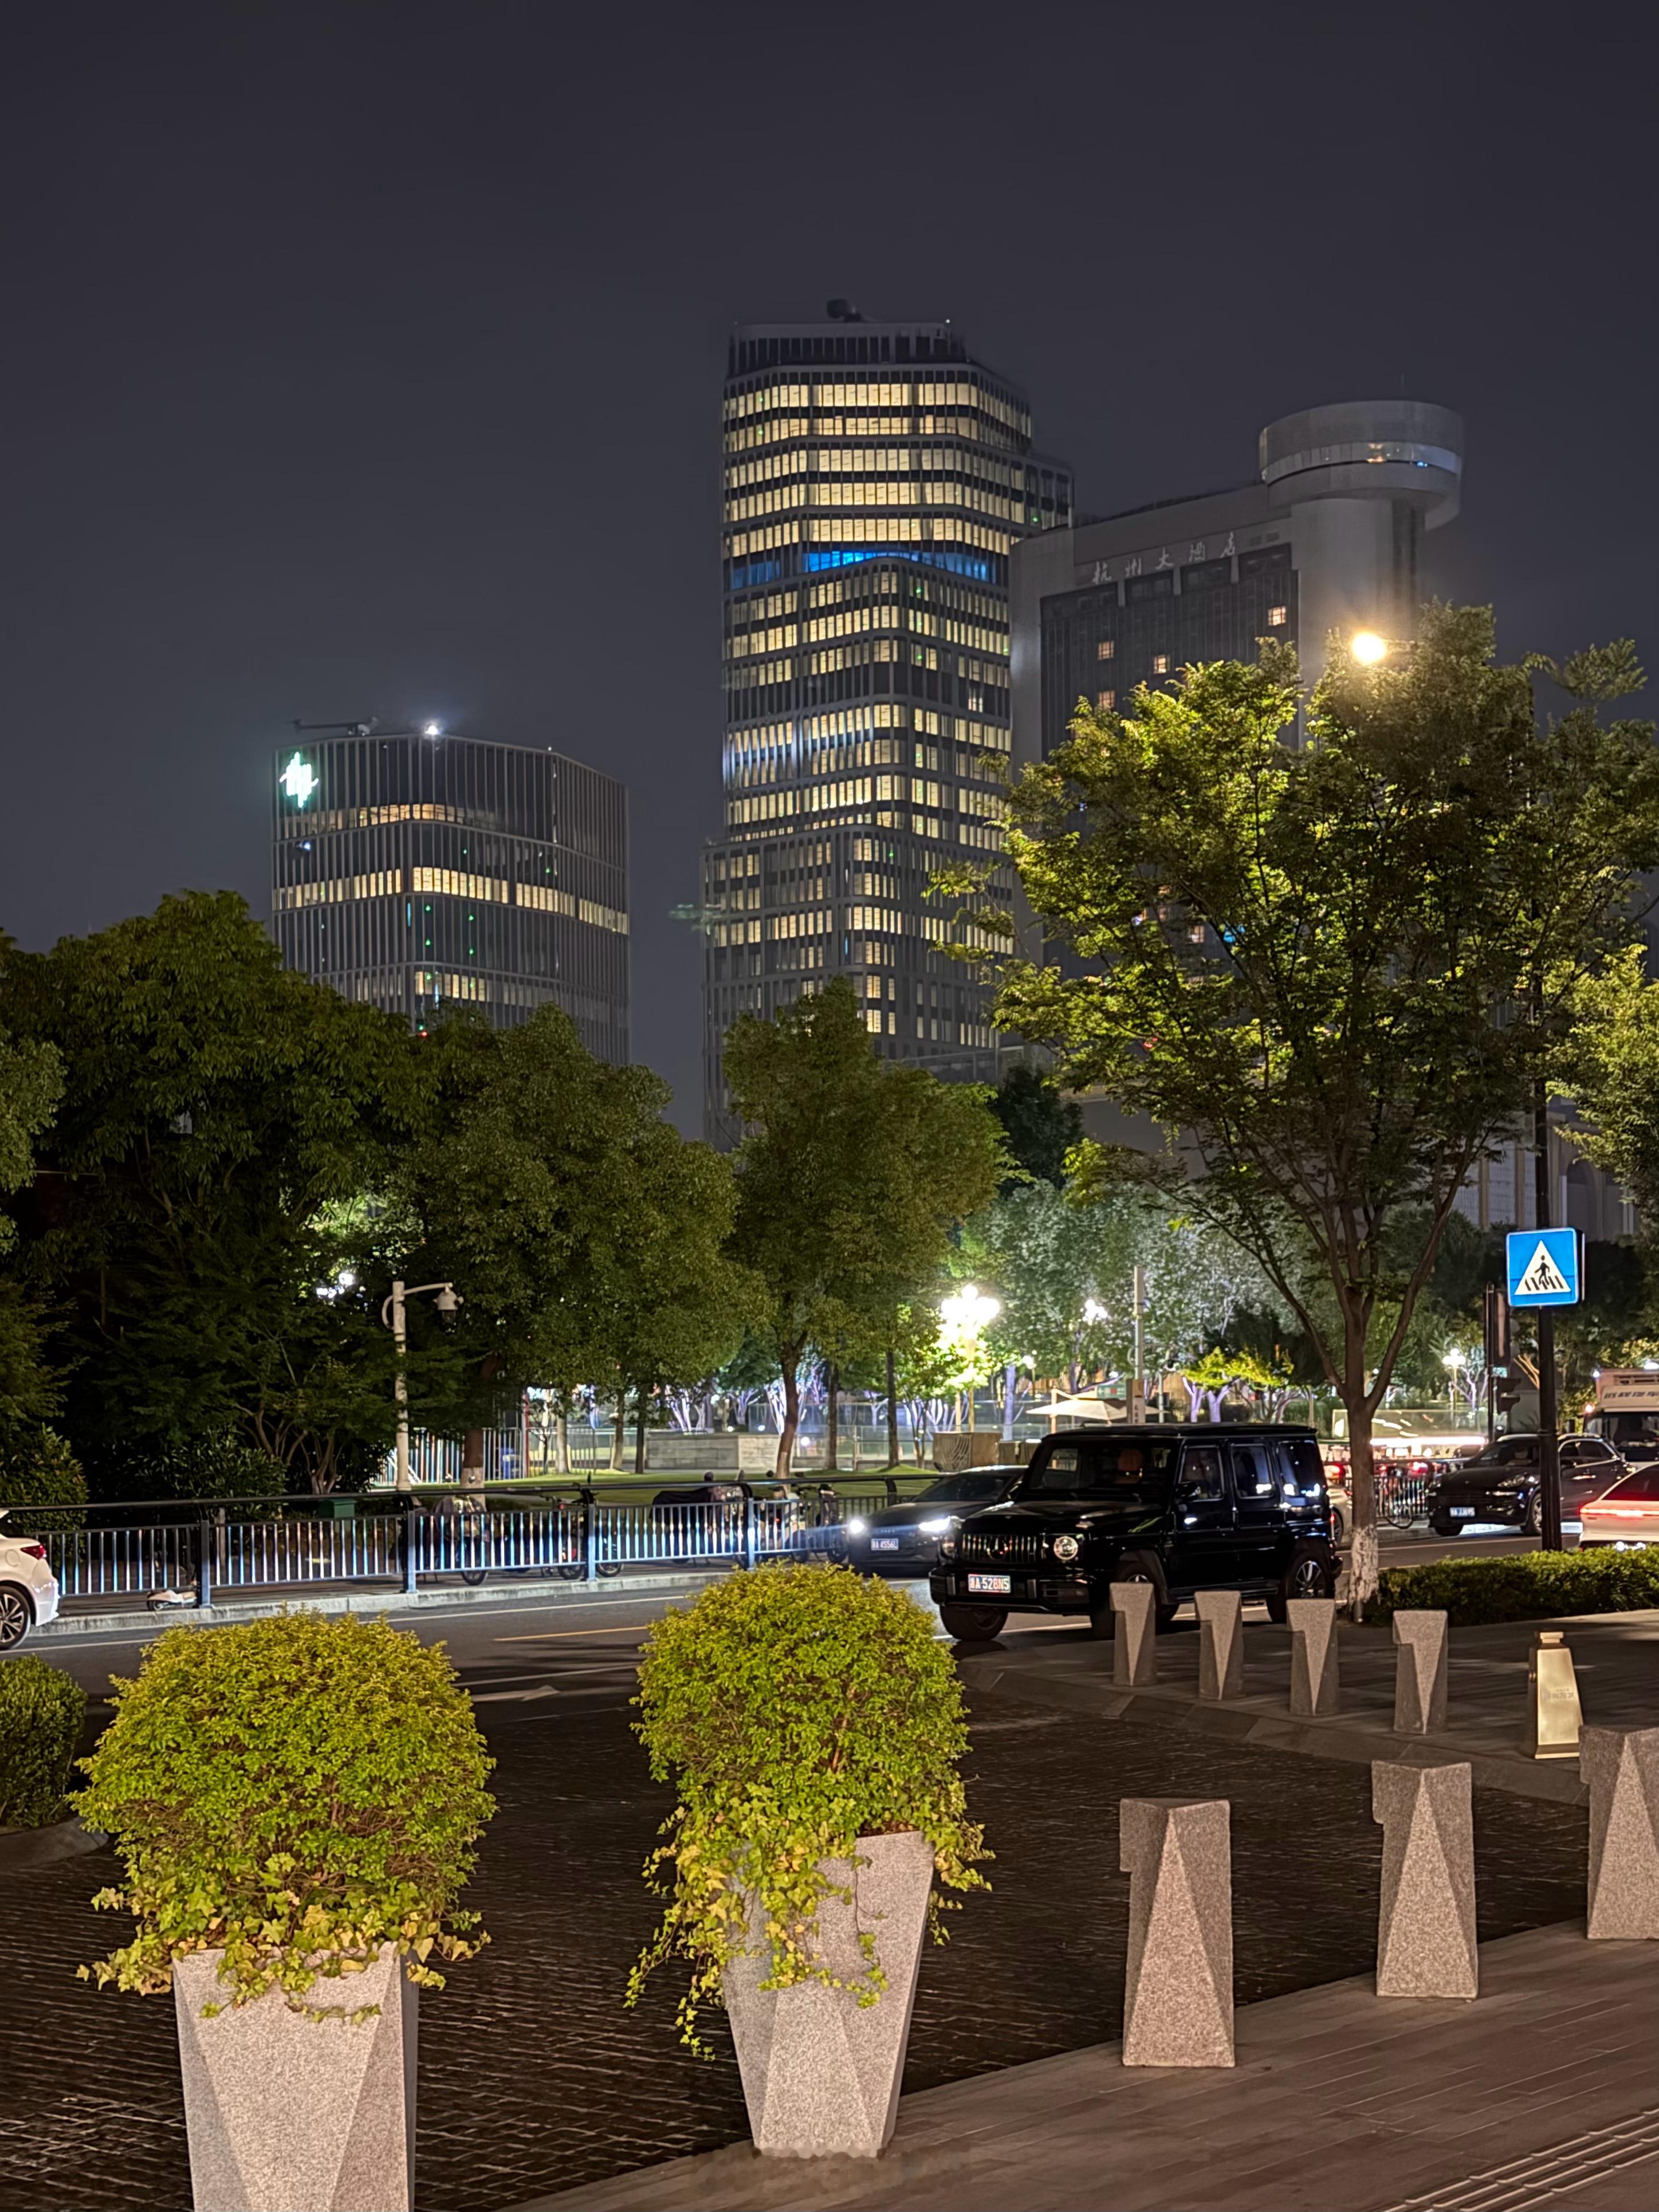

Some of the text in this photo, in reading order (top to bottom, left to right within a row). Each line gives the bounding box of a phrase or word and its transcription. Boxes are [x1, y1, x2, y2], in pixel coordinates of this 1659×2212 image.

[1092, 532, 1236, 584] 杭州大酒店
